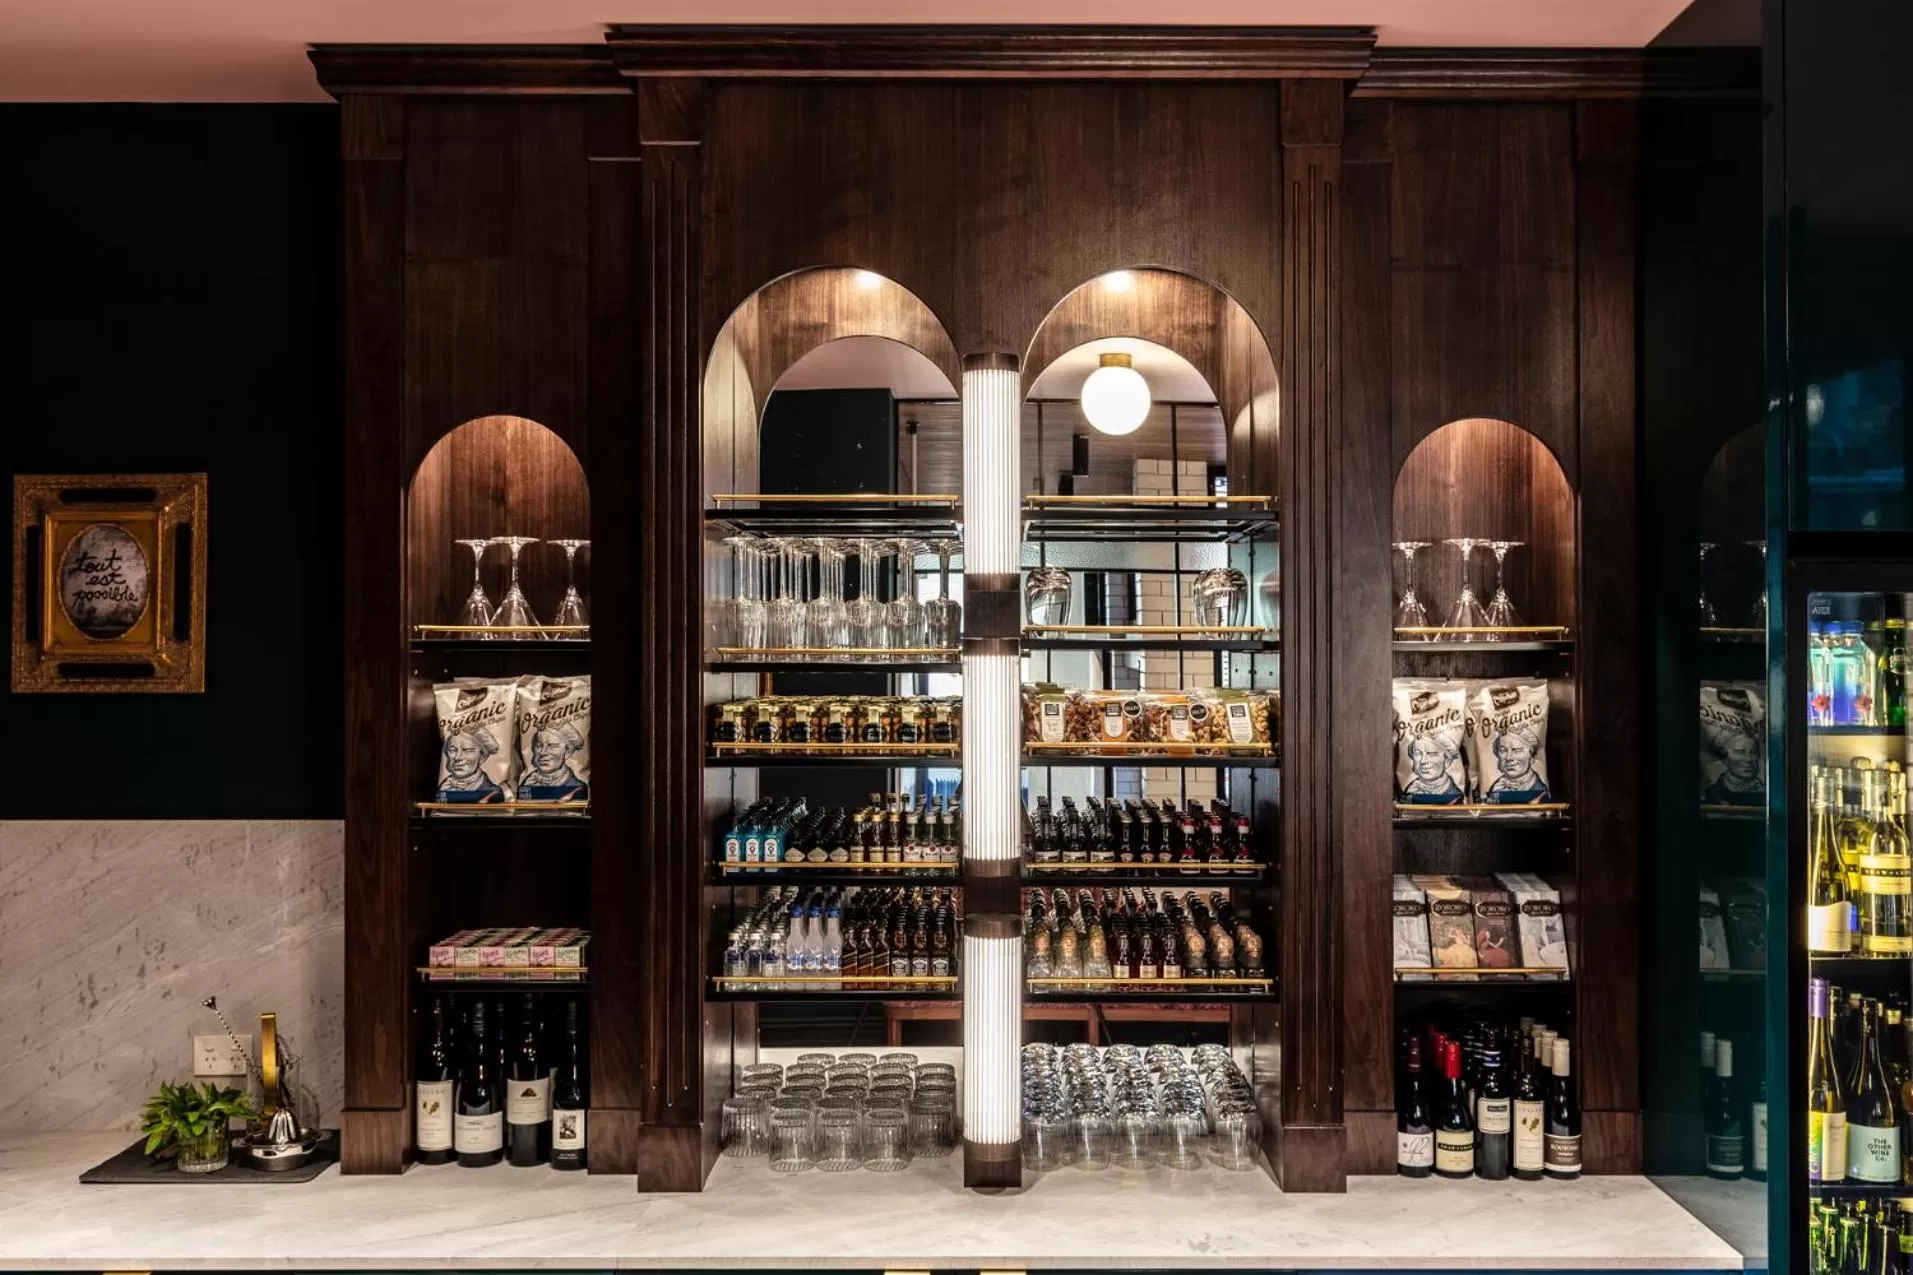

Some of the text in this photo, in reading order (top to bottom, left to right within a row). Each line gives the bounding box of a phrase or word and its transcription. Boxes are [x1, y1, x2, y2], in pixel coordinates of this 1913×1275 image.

[69, 548, 122, 574] tout
[85, 572, 126, 586] est
[72, 585, 138, 608] possible
[521, 697, 590, 734] Organic
[1396, 708, 1461, 741] Organic
[1482, 703, 1542, 738] Organic
